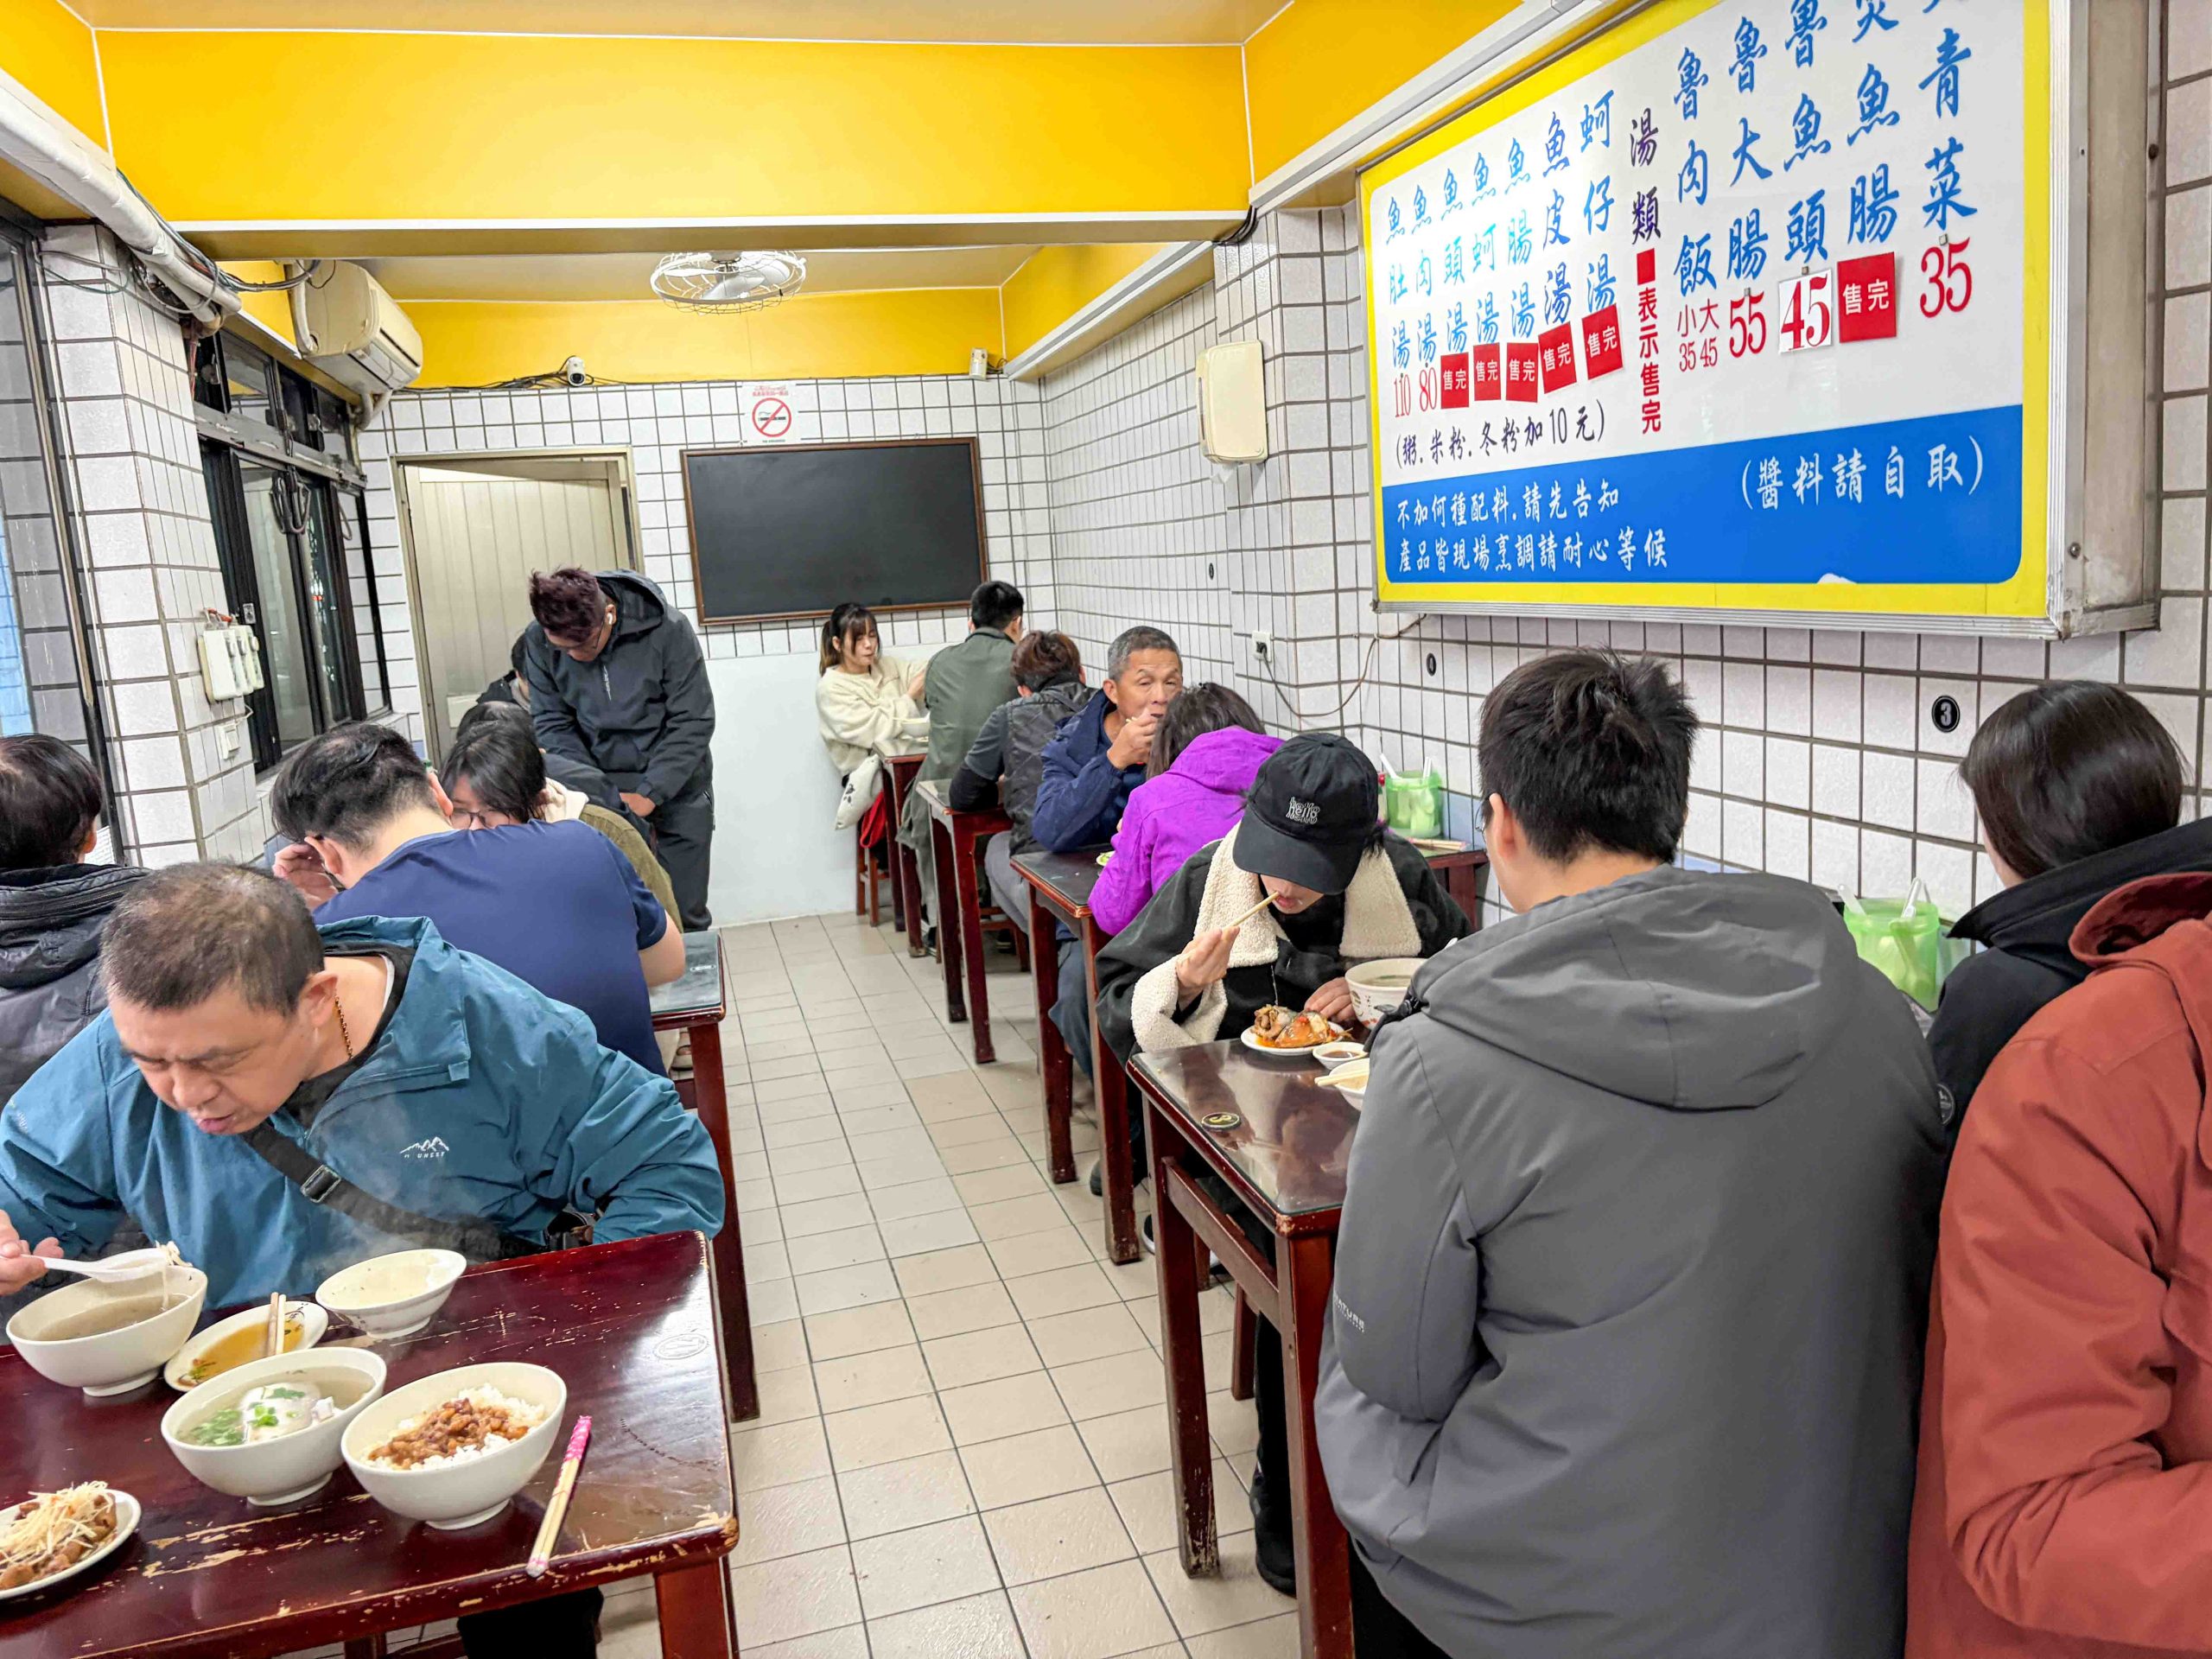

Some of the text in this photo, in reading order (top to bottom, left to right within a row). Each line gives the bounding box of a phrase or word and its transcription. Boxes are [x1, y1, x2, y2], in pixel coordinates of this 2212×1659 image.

[1727, 16, 1774, 282] 魯大腸
[1919, 0, 1978, 231] 青菜
[1630, 108, 1662, 245] 湯類
[1673, 47, 1718, 298] 魯肉飯
[1504, 137, 1536, 339] 魚腸湯
[1542, 111, 1572, 325] 魚皮湯
[1385, 195, 1411, 369] 魚肚湯
[1411, 184, 1438, 364] 魚肉湯
[1440, 168, 1470, 353] 魚頭湯
[1920, 237, 1973, 318] 35
[1677, 298, 1719, 338] 小 大
[1728, 289, 1767, 358] 55
[1780, 273, 1831, 351] 45
[1842, 278, 1891, 316] 售完
[1475, 359, 1499, 382] 售完
[1509, 359, 1536, 382] 售完
[1542, 342, 1572, 372] 售完
[1586, 325, 1618, 358] 售完
[1637, 286, 1662, 435] 表示售完
[1678, 337, 1719, 372] 35 45
[1393, 373, 1412, 417] 110
[1419, 366, 1438, 412] 80
[1442, 369, 1467, 391] 售完
[1741, 435, 1984, 511] (醬料請自取)
[1398, 525, 1668, 575] 產品皆現場烹調請耐心等候
[1940, 701, 1952, 727] 3
